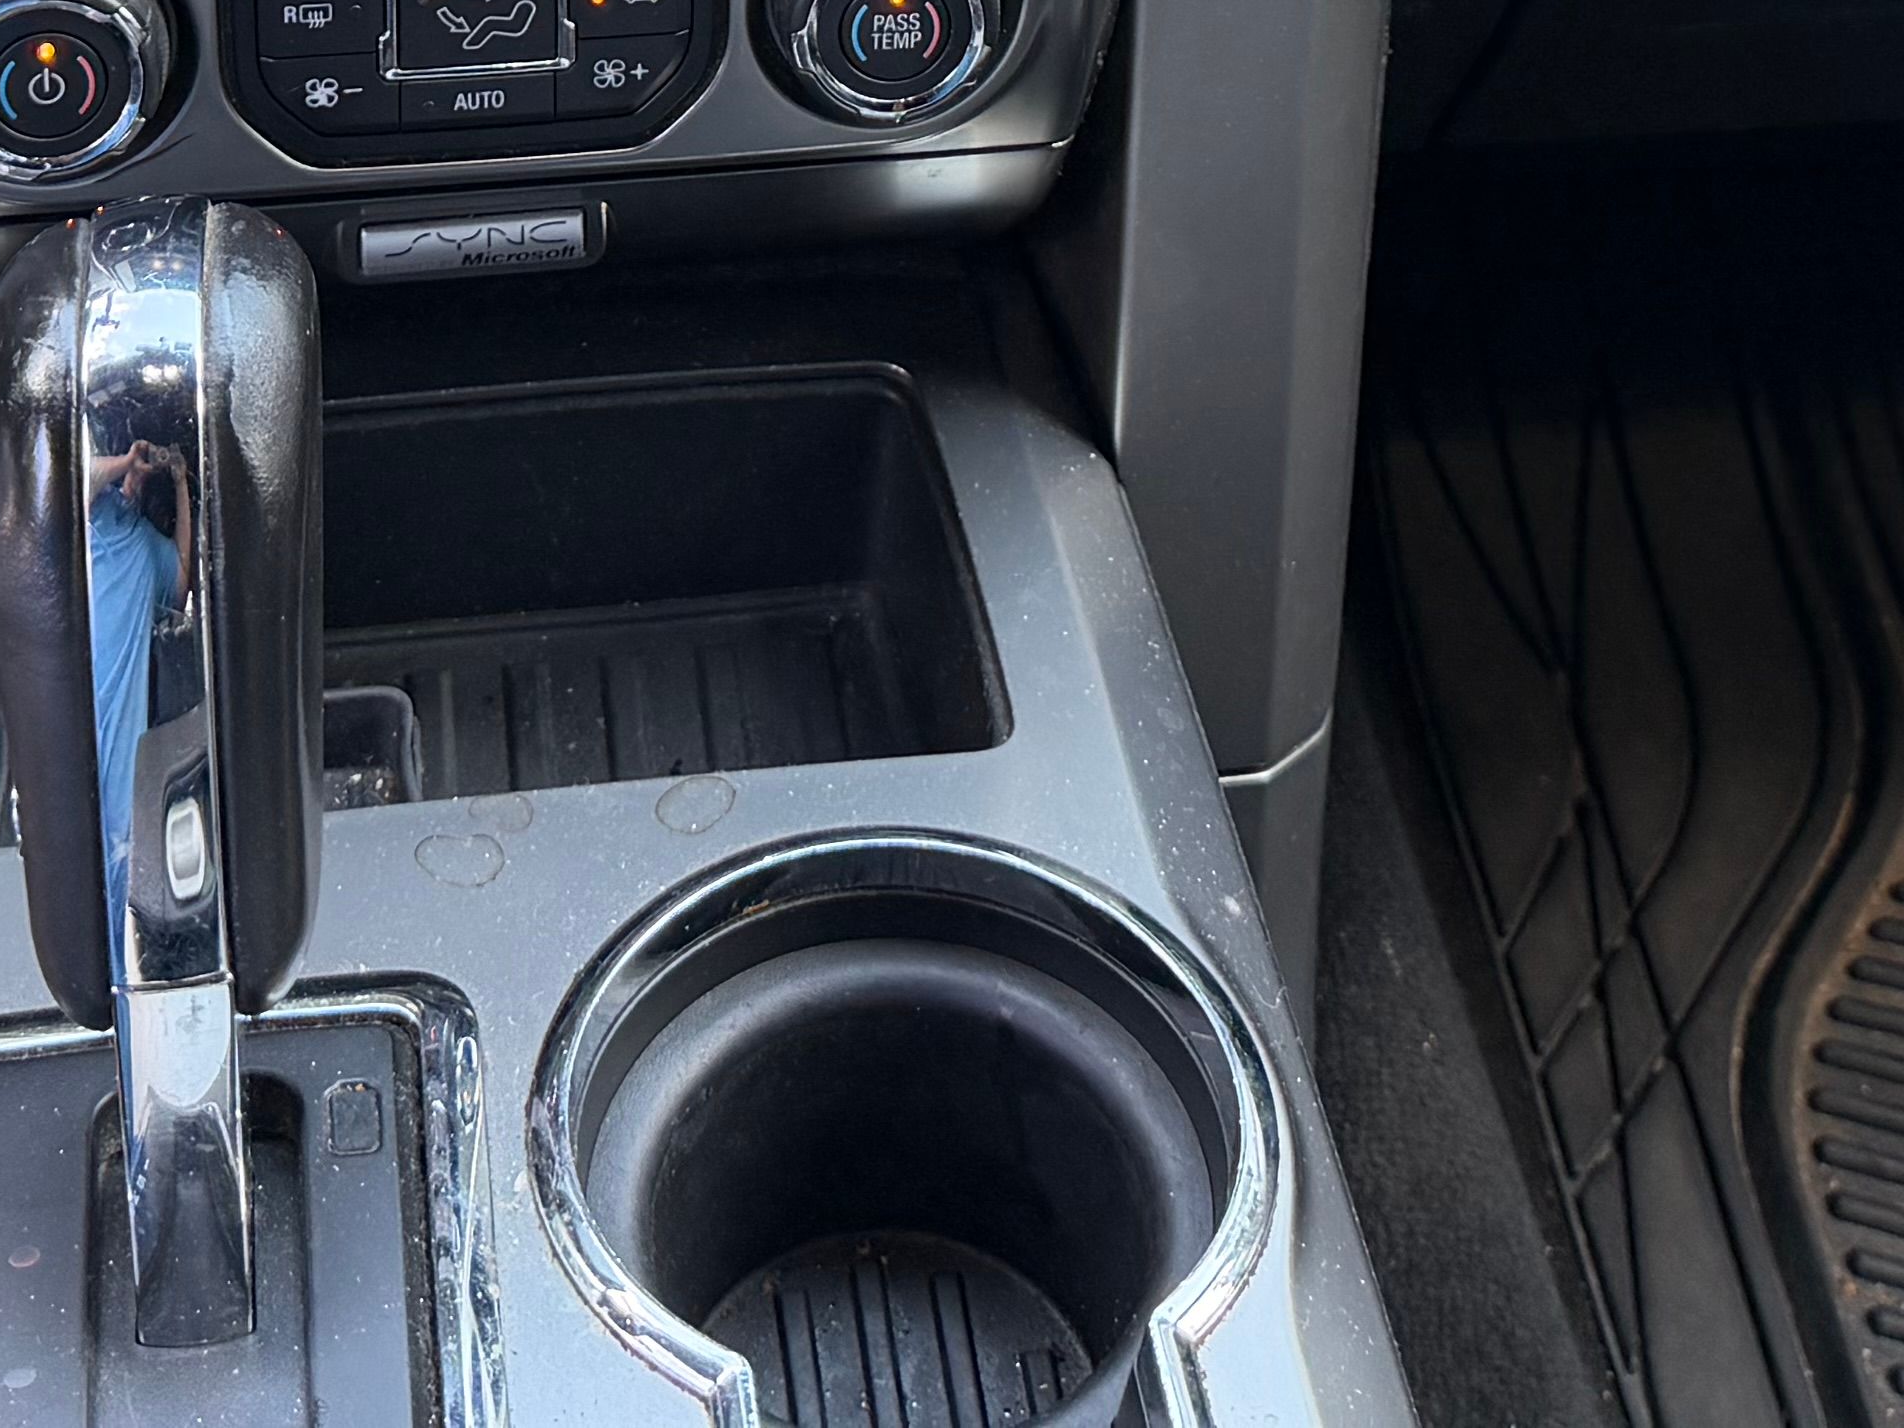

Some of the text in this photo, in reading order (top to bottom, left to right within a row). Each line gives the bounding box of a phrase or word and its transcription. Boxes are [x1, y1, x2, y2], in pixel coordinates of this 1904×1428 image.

[872, 13, 922, 34] PASS
[870, 29, 923, 52] TEMP
[453, 89, 506, 112] AUTO
[384, 220, 568, 258] SYNC
[460, 244, 577, 267] Microsoft
